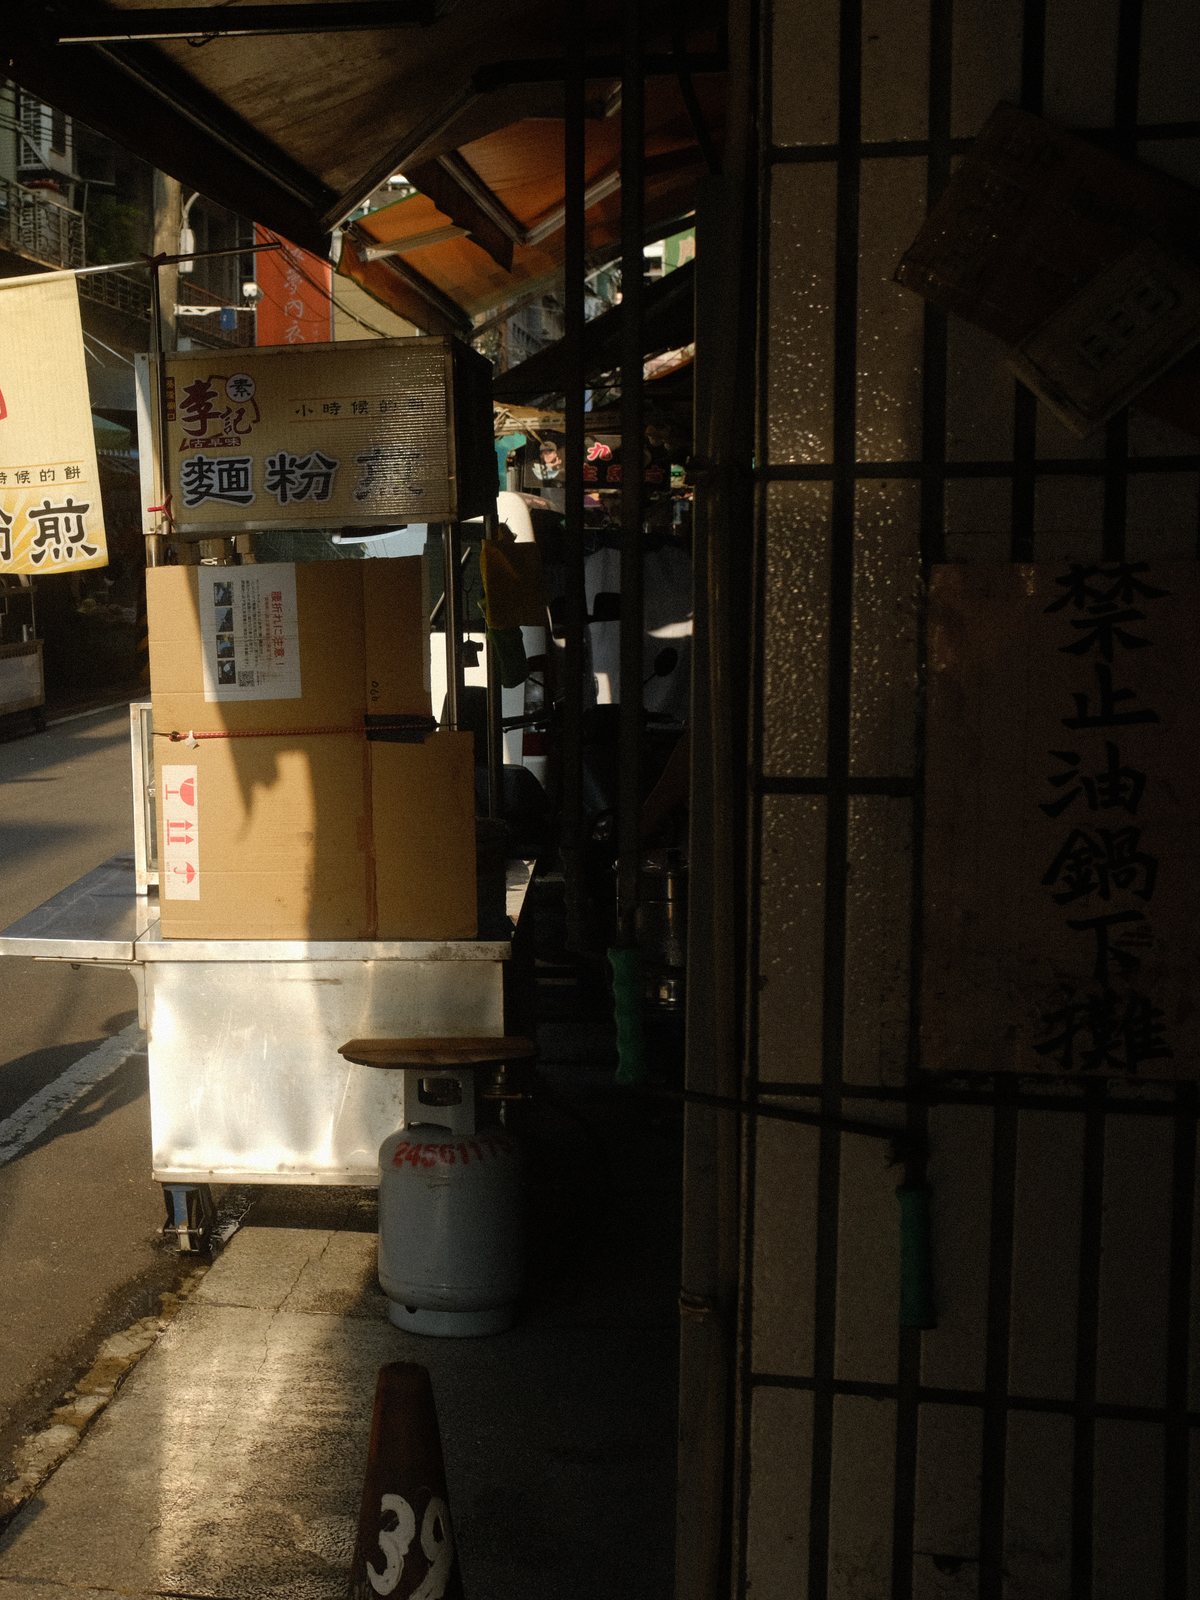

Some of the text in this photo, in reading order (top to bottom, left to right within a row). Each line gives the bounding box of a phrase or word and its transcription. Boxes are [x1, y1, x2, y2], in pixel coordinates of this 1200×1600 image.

[179, 380, 253, 437] 李記
[229, 378, 253, 398] 素
[1033, 562, 1174, 1073] 禁止油鍋下攤
